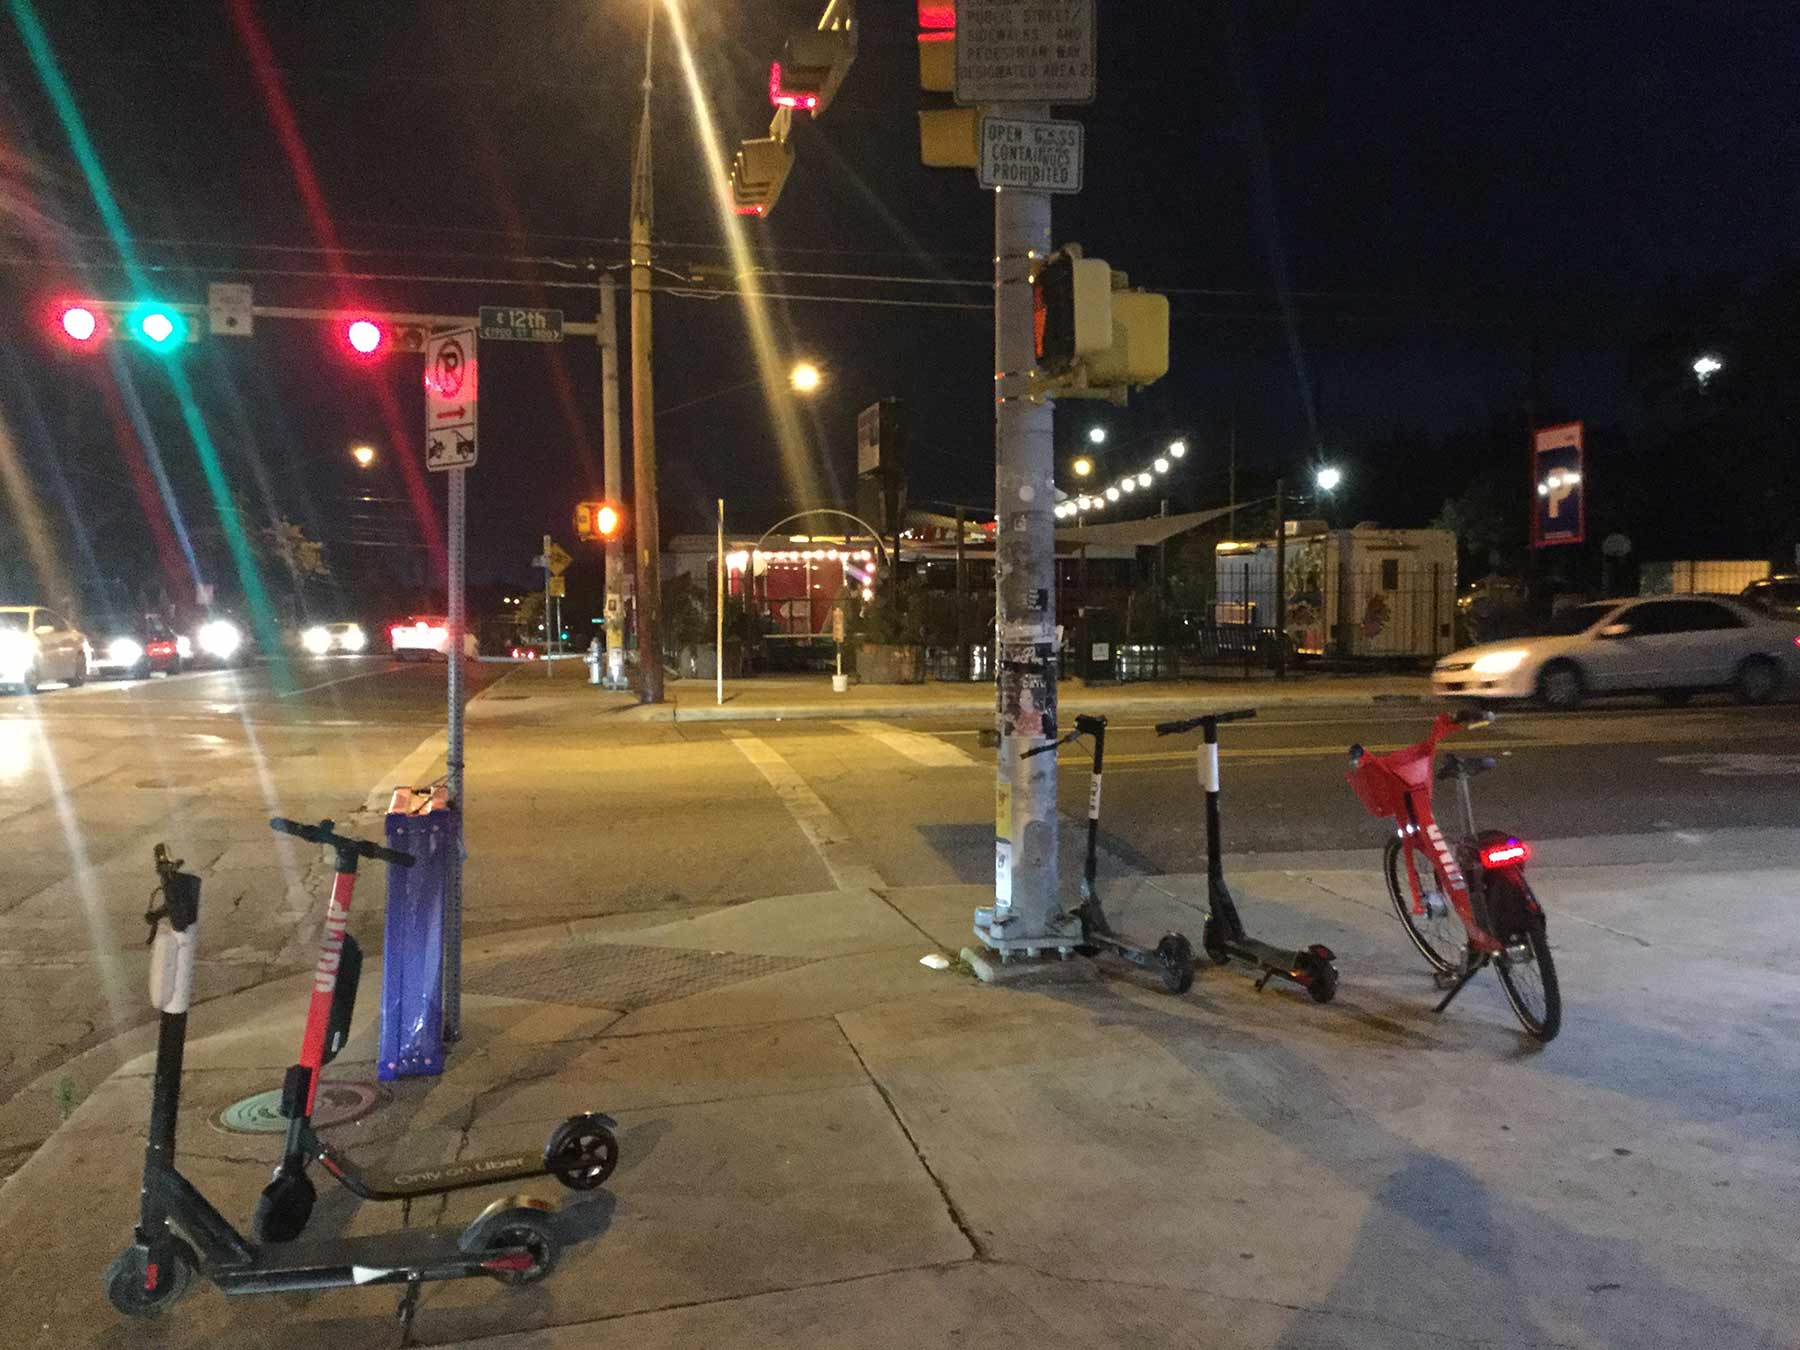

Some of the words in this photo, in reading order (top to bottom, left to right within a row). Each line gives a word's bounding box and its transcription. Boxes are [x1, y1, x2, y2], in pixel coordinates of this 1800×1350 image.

[988, 124, 1022, 143] OPEN
[1034, 127, 1076, 147] GSS
[991, 144, 1071, 168] CONTAINS
[993, 163, 1069, 184] PROHIBITED
[509, 311, 546, 329] 12th
[314, 899, 348, 993] JUMP
[394, 1170, 440, 1186] Only
[446, 1166, 471, 1177] on
[475, 1158, 524, 1172] Uber
